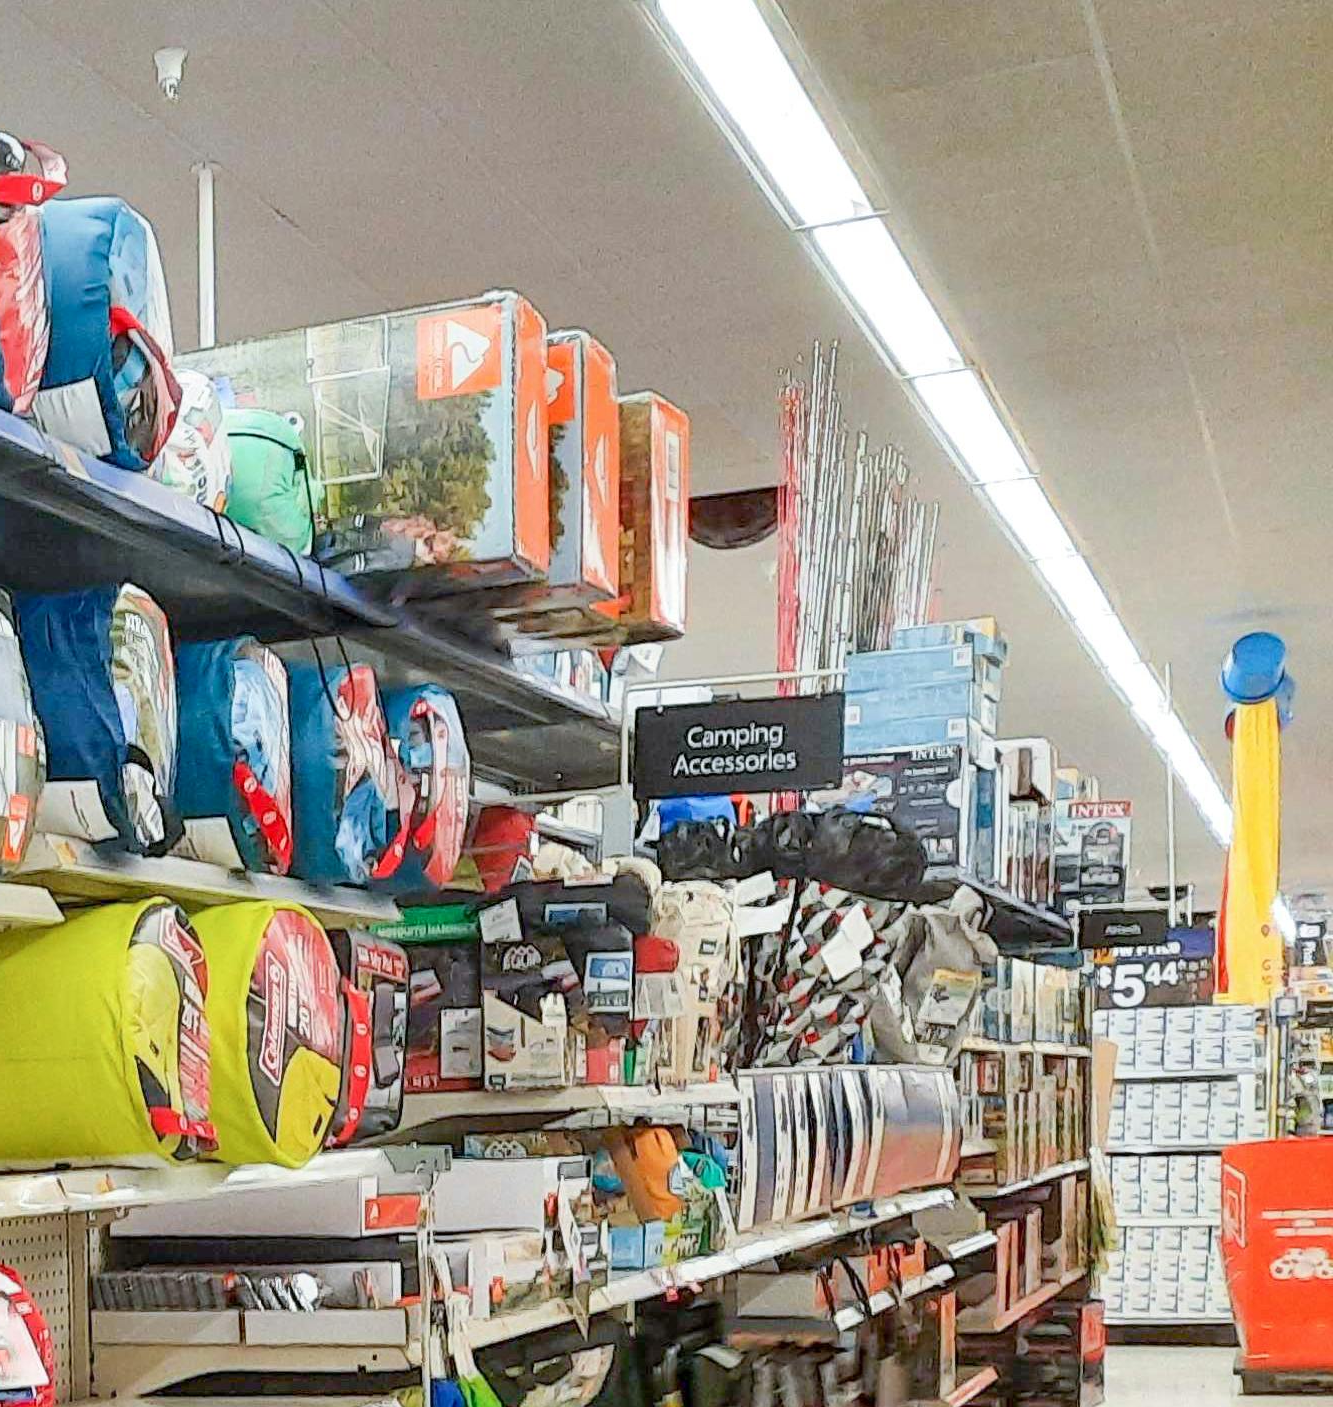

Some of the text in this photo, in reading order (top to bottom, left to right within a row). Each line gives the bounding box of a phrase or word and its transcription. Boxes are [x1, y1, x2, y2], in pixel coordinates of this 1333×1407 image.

[687, 722, 784, 750] Camping
[673, 750, 798, 777] Accessories
[1070, 802, 1127, 818] INTEX
[263, 983, 283, 1068] Coleman
